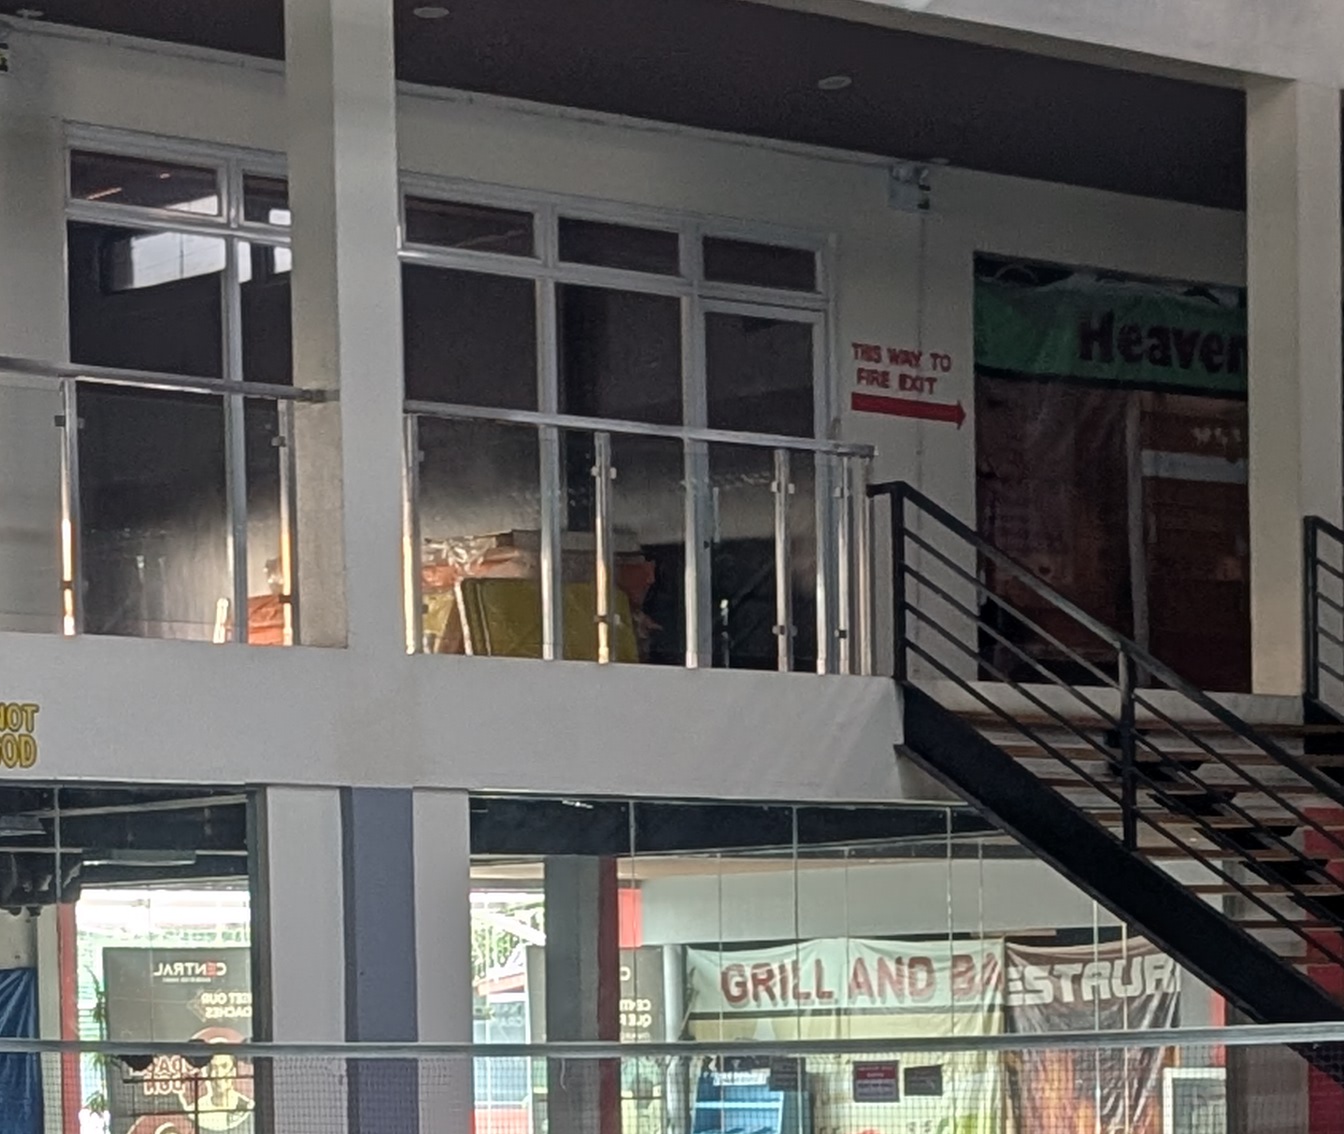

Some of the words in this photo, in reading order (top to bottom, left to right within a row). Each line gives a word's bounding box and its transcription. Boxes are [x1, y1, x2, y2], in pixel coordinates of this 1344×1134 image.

[851, 342, 882, 364] THIS
[887, 347, 922, 368] WAY
[930, 353, 952, 372] TO
[857, 367, 890, 389] FIRE
[899, 373, 937, 395] EXIT
[721, 957, 838, 1007] GRILL
[848, 956, 935, 1003] AND
[1007, 953, 1181, 1006] ESTAUR
